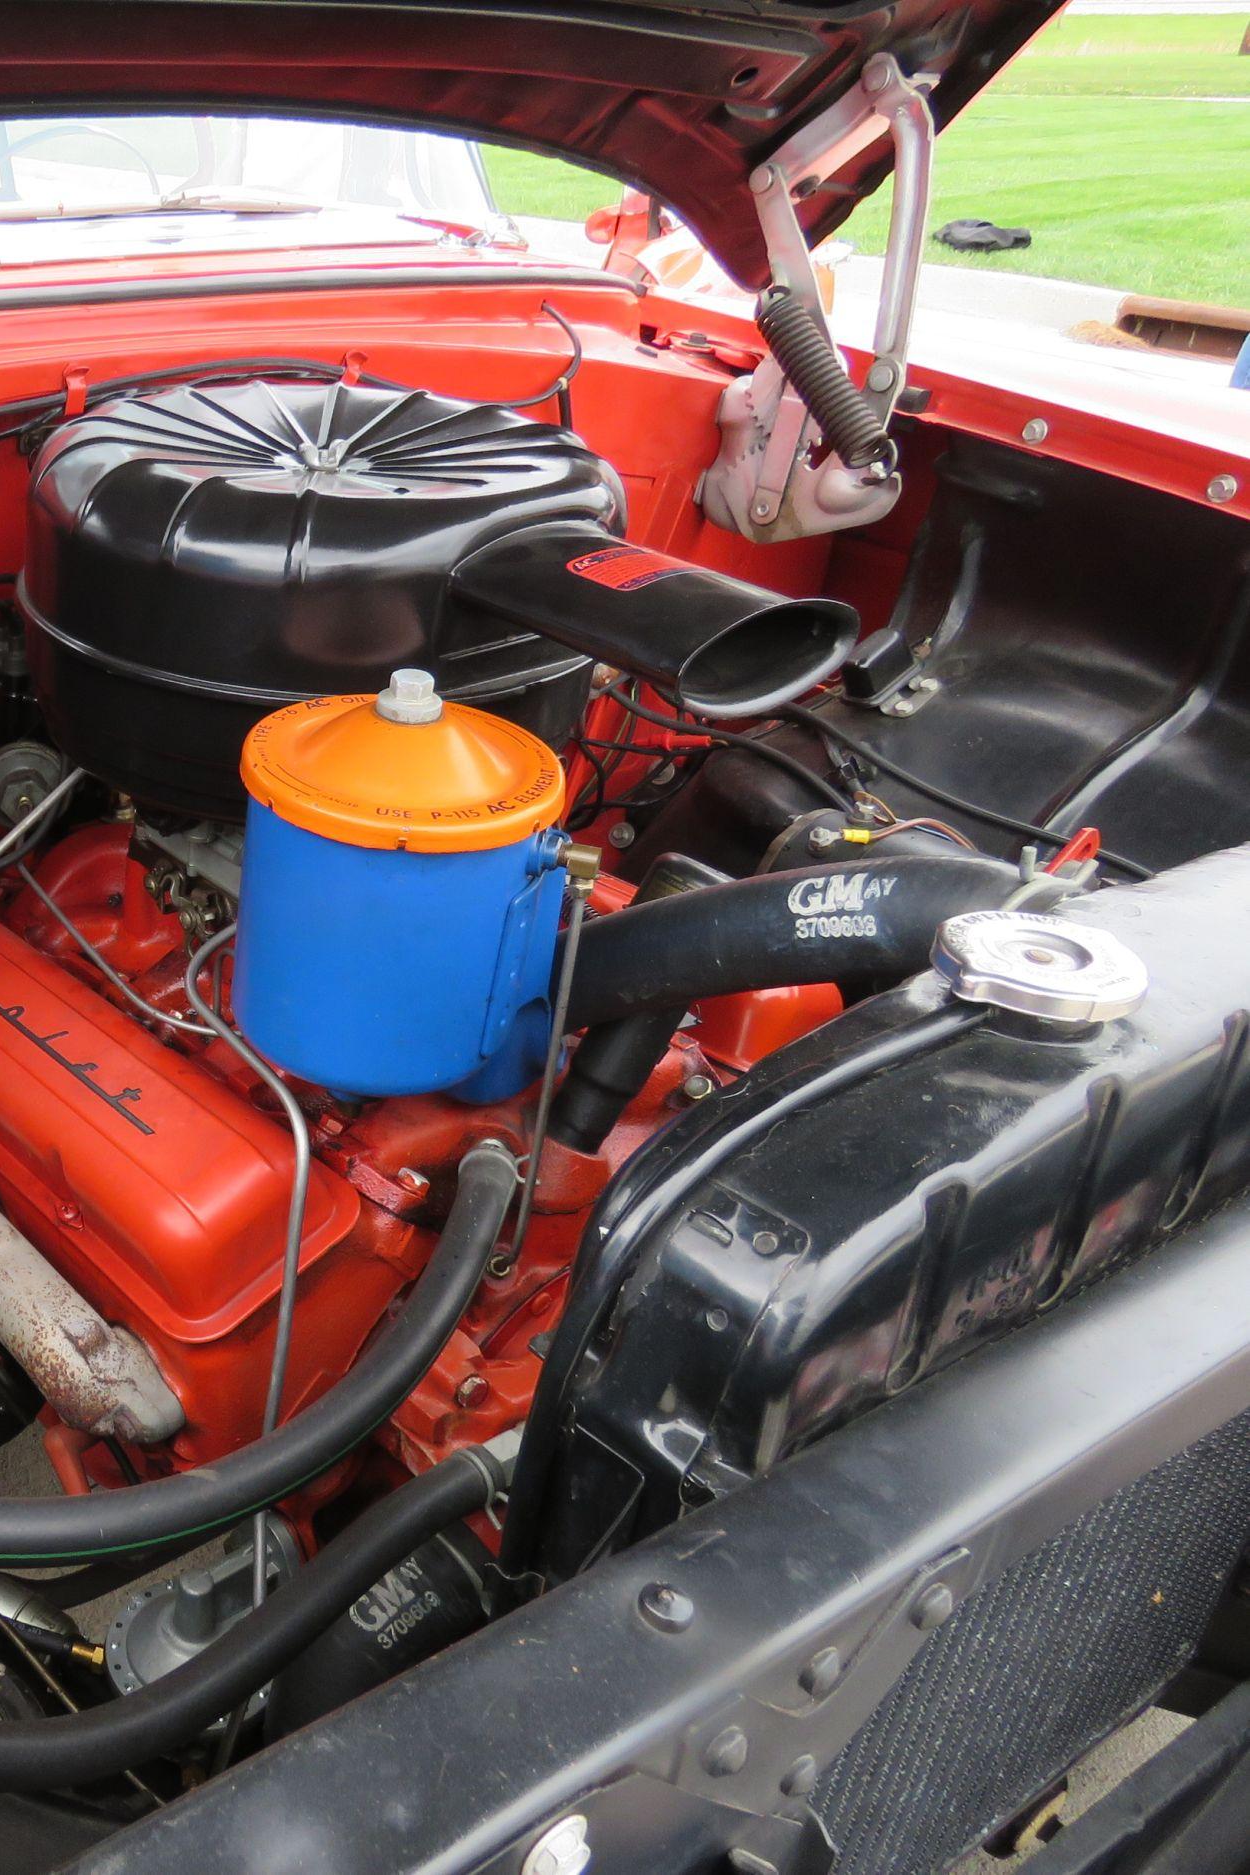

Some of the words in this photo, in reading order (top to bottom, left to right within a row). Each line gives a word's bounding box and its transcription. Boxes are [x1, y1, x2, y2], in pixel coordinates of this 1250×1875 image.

[253, 724, 272, 743] TYPE
[305, 698, 331, 710] AC
[341, 696, 368, 704] OIL
[376, 807, 412, 819] USE
[431, 809, 480, 820] P-115
[487, 800, 516, 814] AC
[514, 768, 556, 804] ELEMENT
